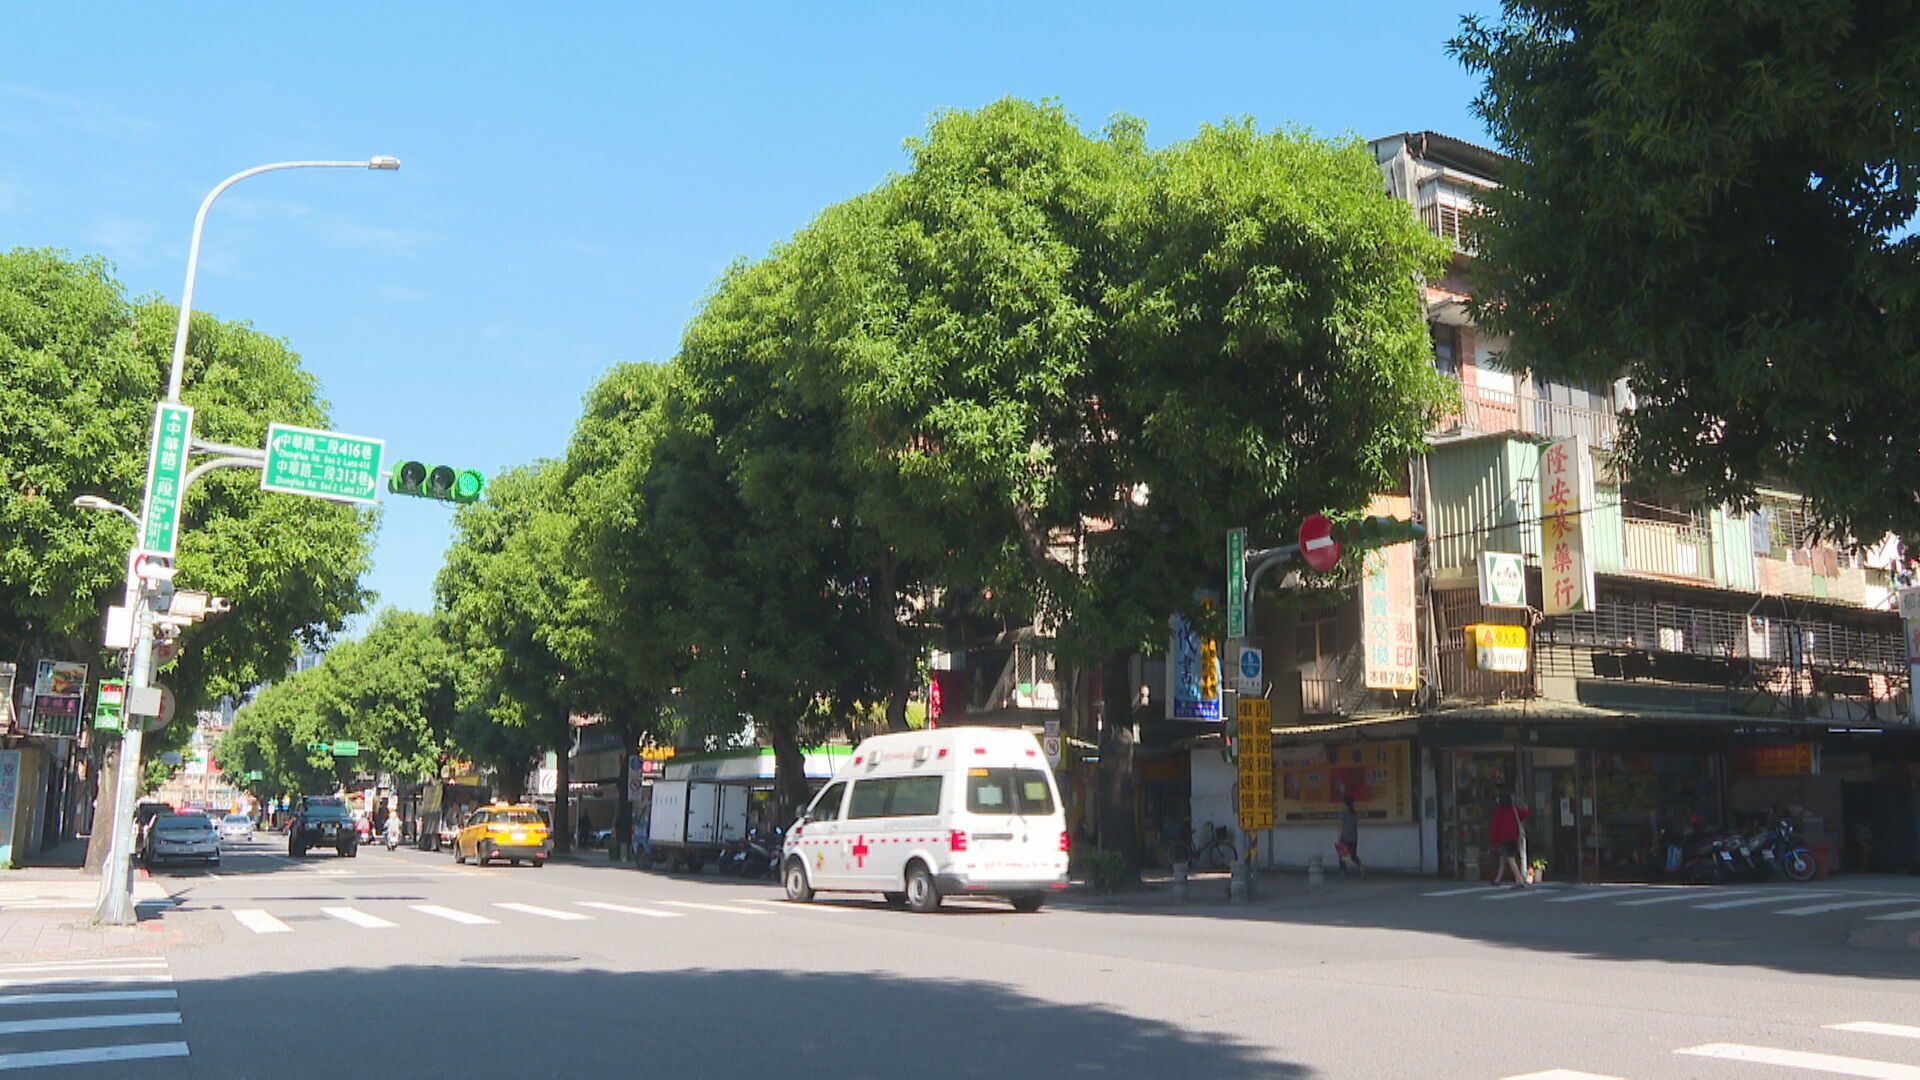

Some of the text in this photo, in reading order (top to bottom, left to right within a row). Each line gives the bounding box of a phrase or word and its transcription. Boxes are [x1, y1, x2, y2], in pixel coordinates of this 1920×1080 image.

[156, 422, 180, 497] 中華路二段
[280, 433, 372, 460] 中華路二段416巷
[277, 459, 369, 486] 中華路二段313巷
